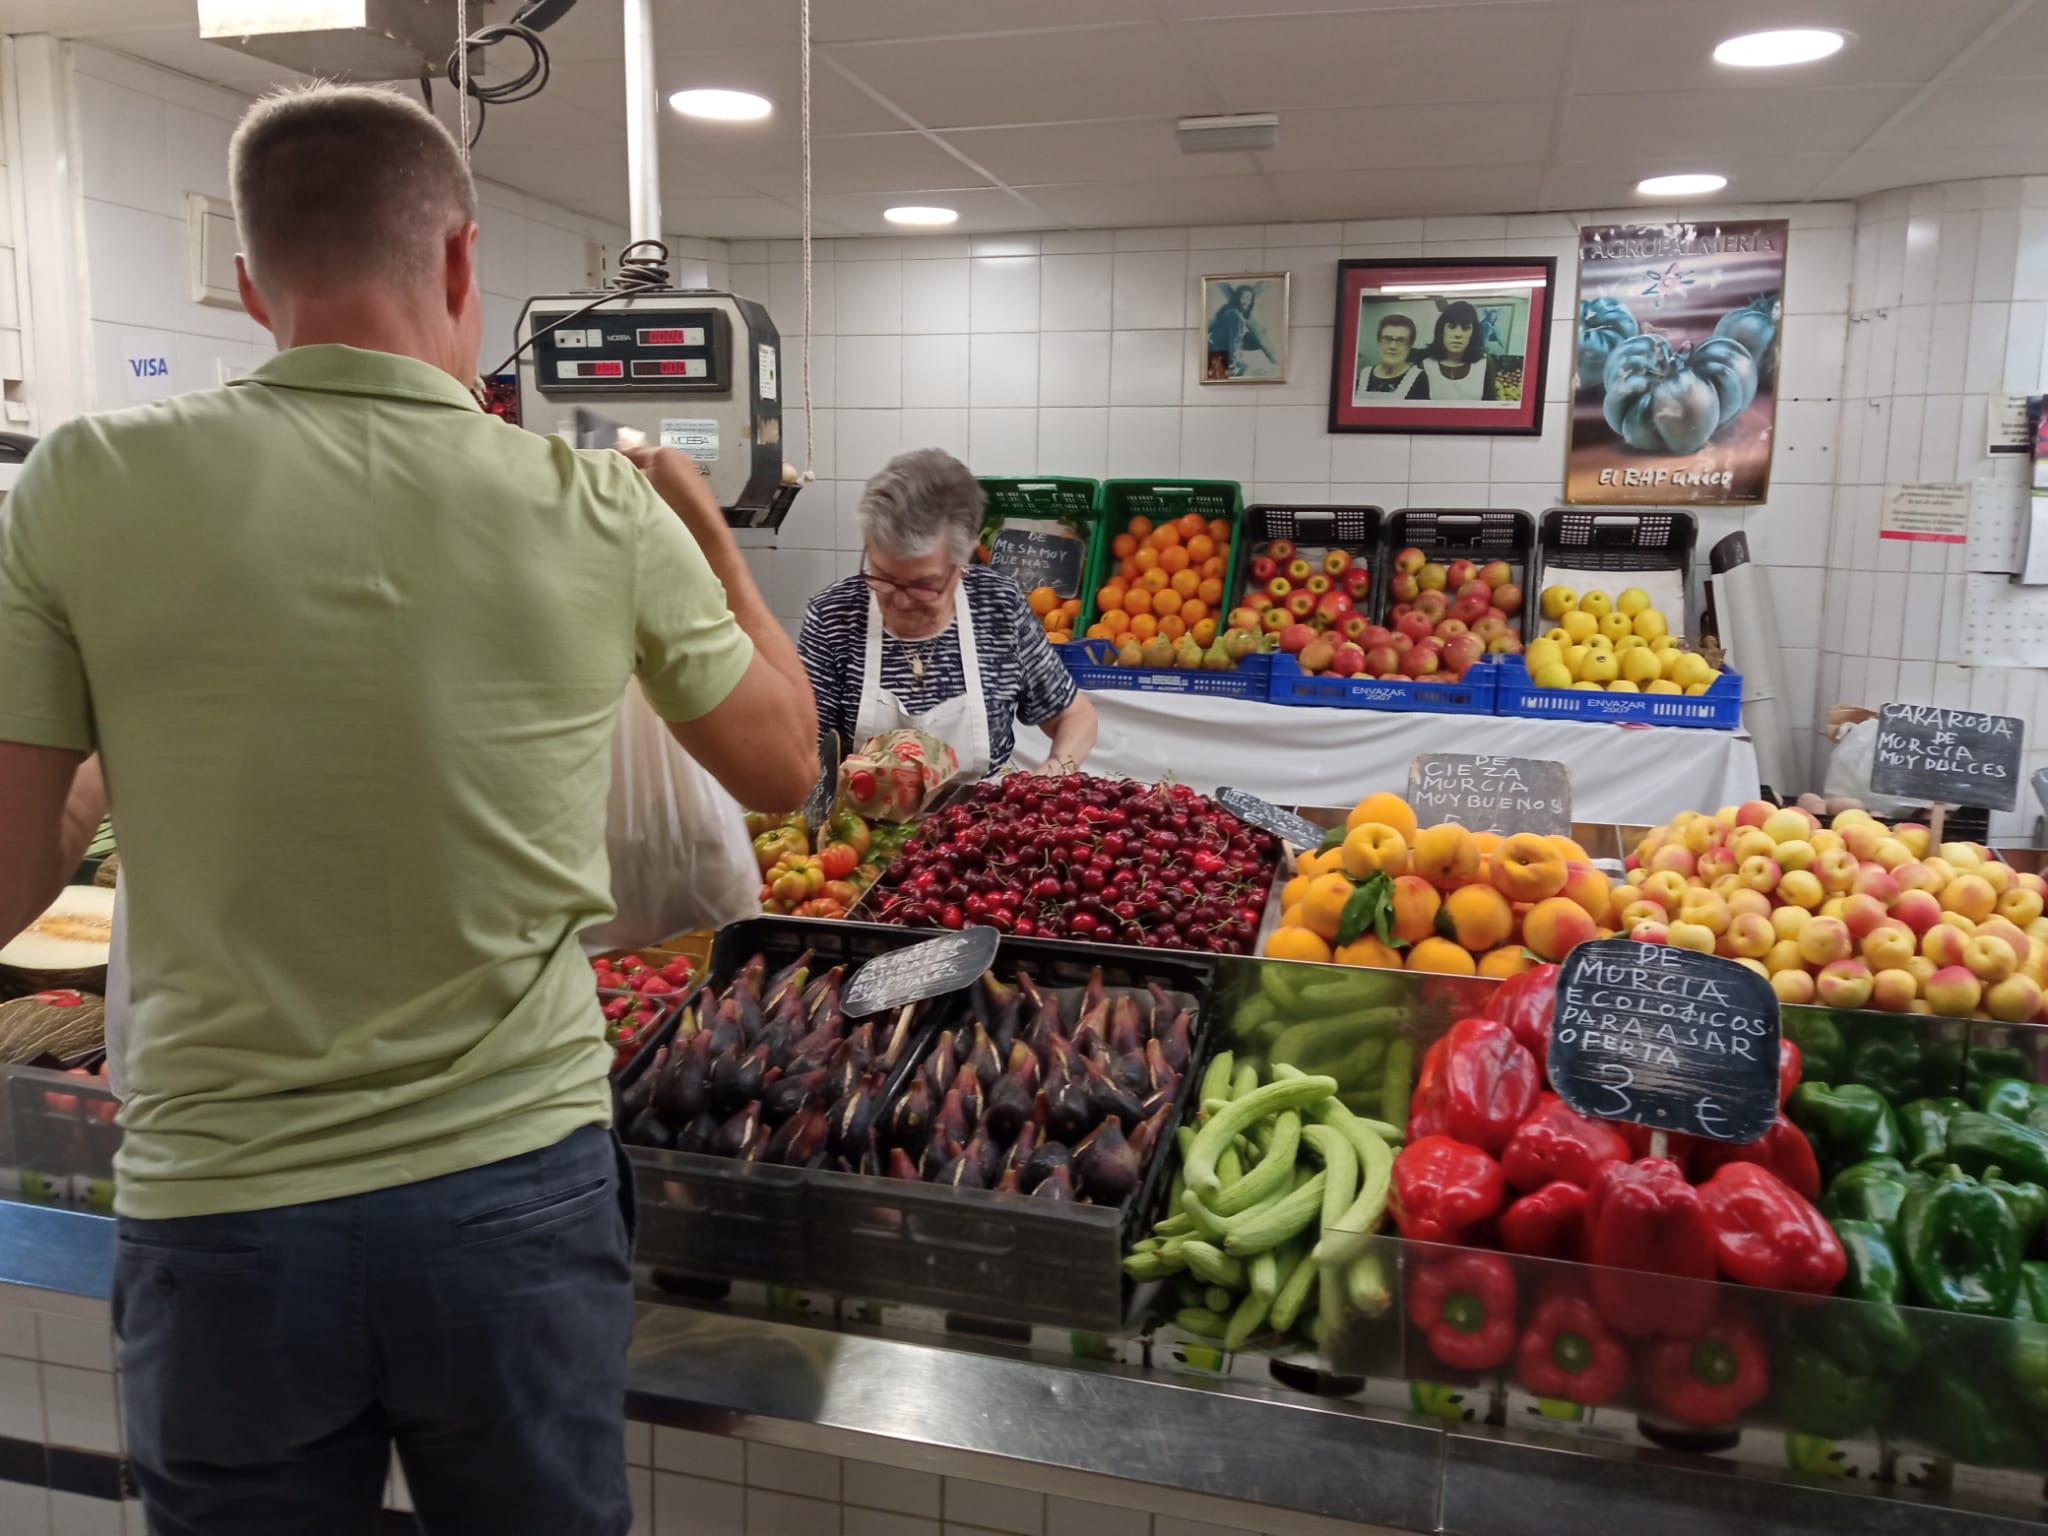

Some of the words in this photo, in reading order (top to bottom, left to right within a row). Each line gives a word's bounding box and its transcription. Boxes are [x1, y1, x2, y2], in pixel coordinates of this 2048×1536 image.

[129, 357, 169, 377] VISA
[1623, 466, 1669, 488] RAF
[1028, 531, 1047, 543] DE
[1352, 686, 1407, 696] ENVAZAR
[1587, 699, 1646, 709] ENVAZAR
[1932, 731, 1959, 745] DE
[1475, 756, 1508, 766] DE
[1925, 758, 2007, 778] DULCES
[1424, 762, 1521, 780] CIEZA
[1423, 777, 1529, 793] MURCIA
[1416, 791, 1460, 808] MUY
[1467, 797, 1563, 814] BUENOS
[1637, 944, 1682, 967] DE
[1562, 1006, 1643, 1039] PARA
[1656, 1024, 1758, 1061] ASAR
[1559, 1029, 1681, 1068] OFERTA
